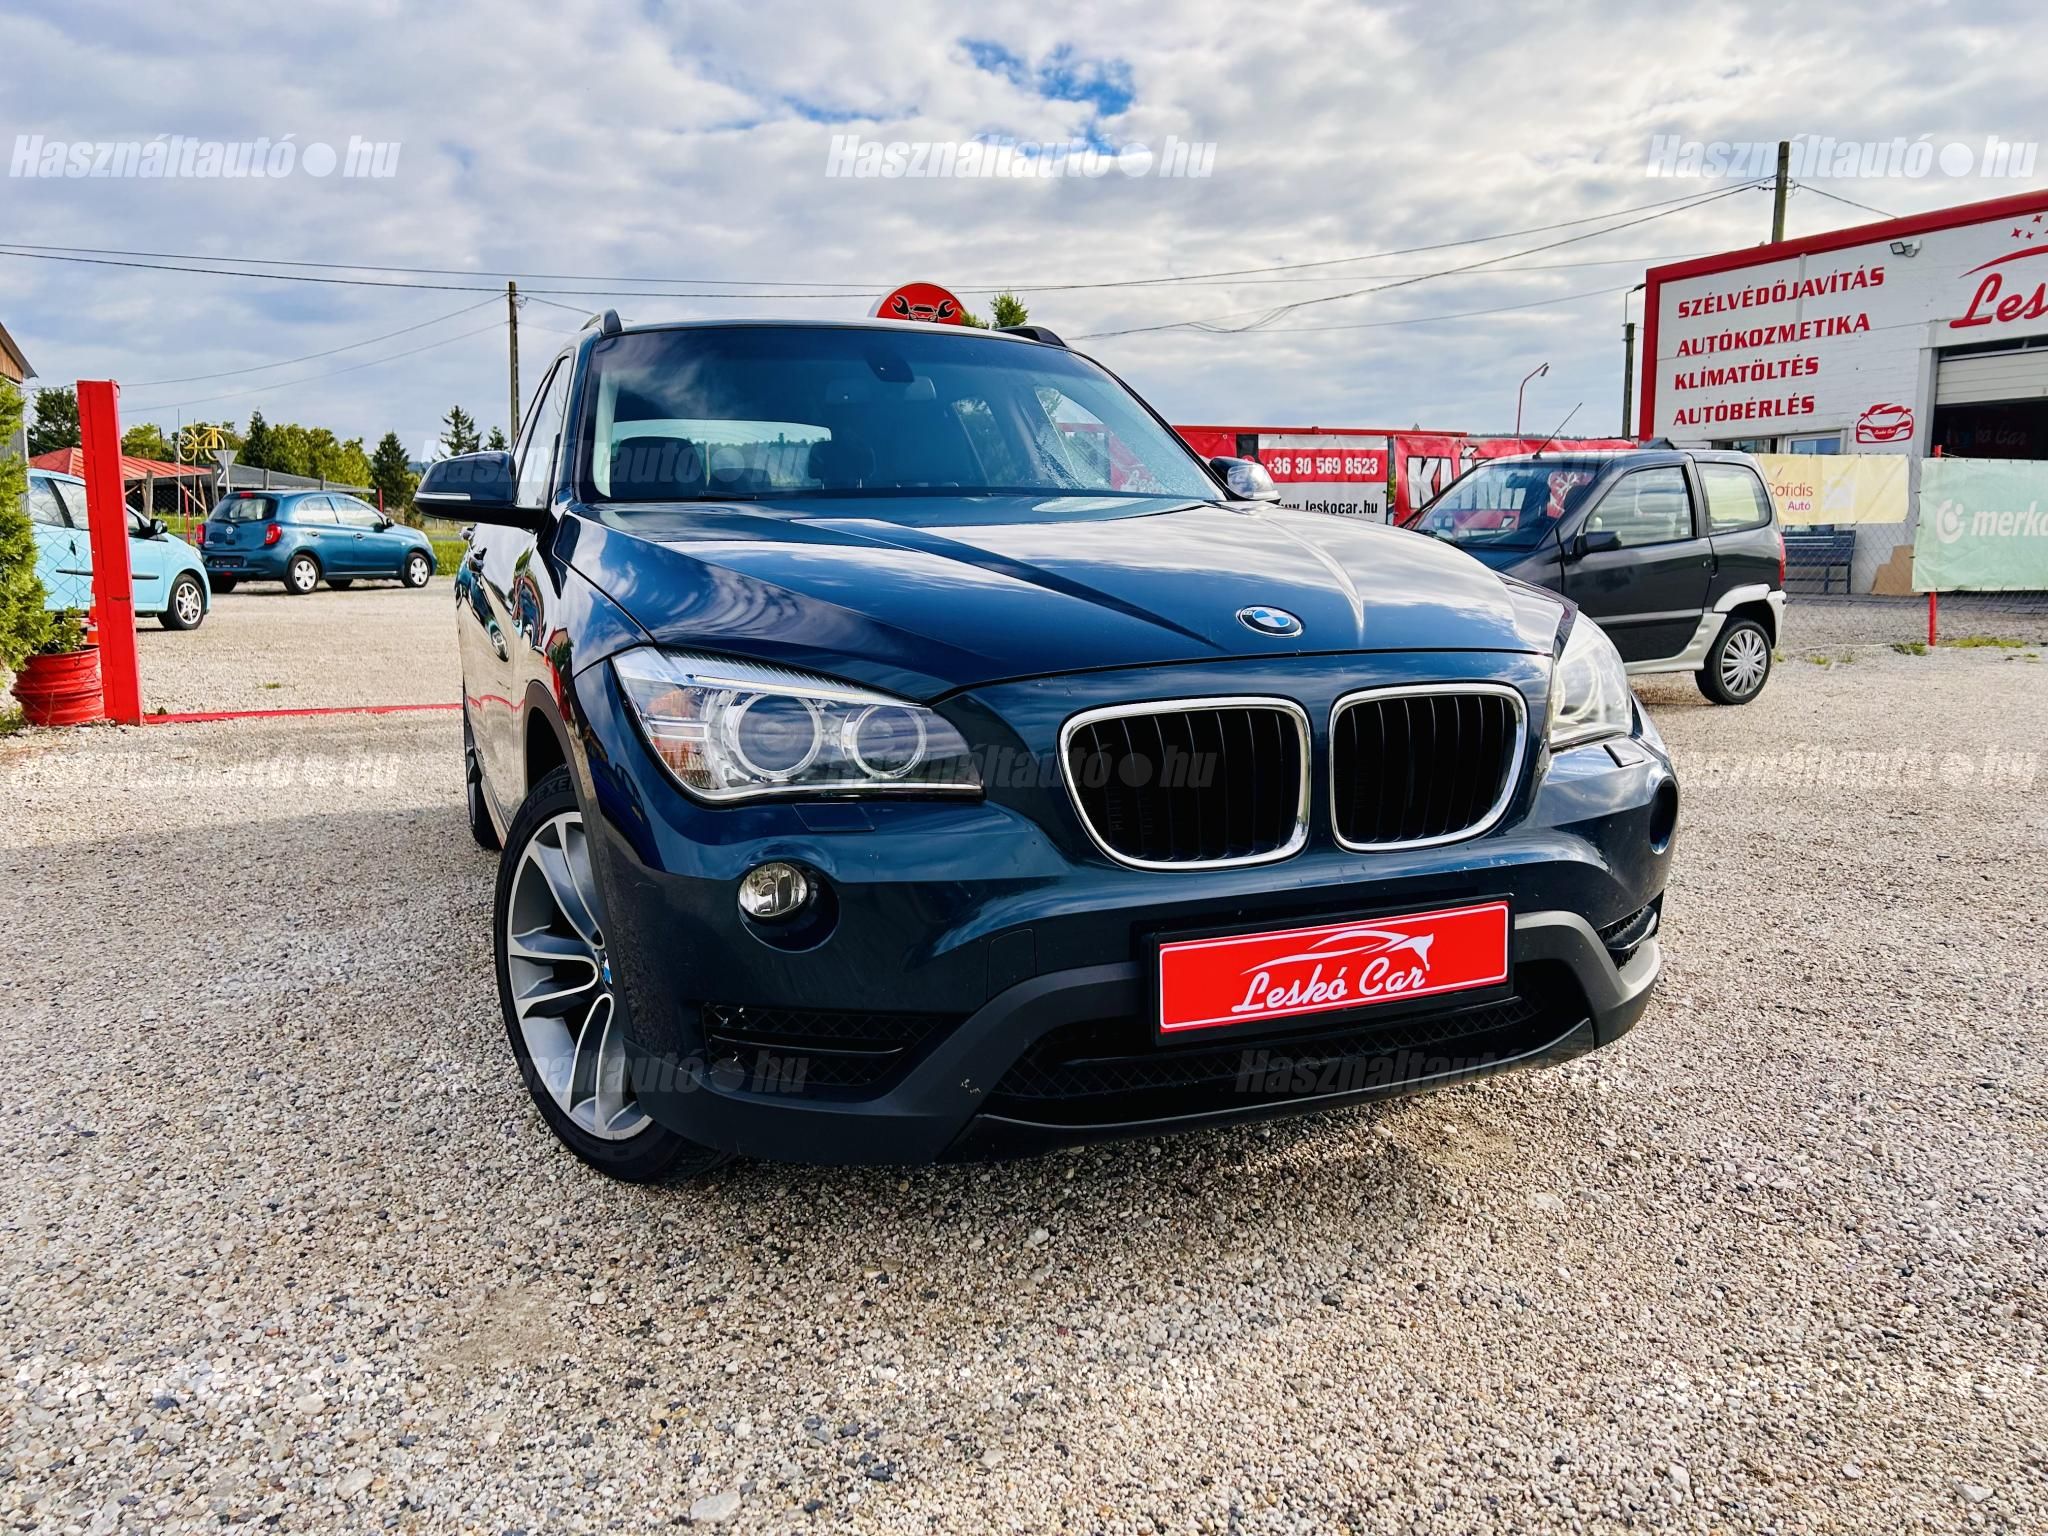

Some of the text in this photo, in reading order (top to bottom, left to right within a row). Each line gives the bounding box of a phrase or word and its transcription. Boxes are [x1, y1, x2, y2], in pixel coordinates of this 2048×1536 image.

[1678, 264, 1885, 319] SZÉLVÉDŐJAVÍTÁS
[1676, 312, 1870, 358] AUTÓKOZMETIKA
[1674, 353, 1819, 391] KLÍMATÖLTÉS
[1673, 392, 1815, 426] AUTÓBÉRLÉS
[1266, 457, 1378, 475] +36 30 569 8523
[1788, 501, 1811, 511] Autó
[1231, 957, 1426, 1014] Leskó Car
